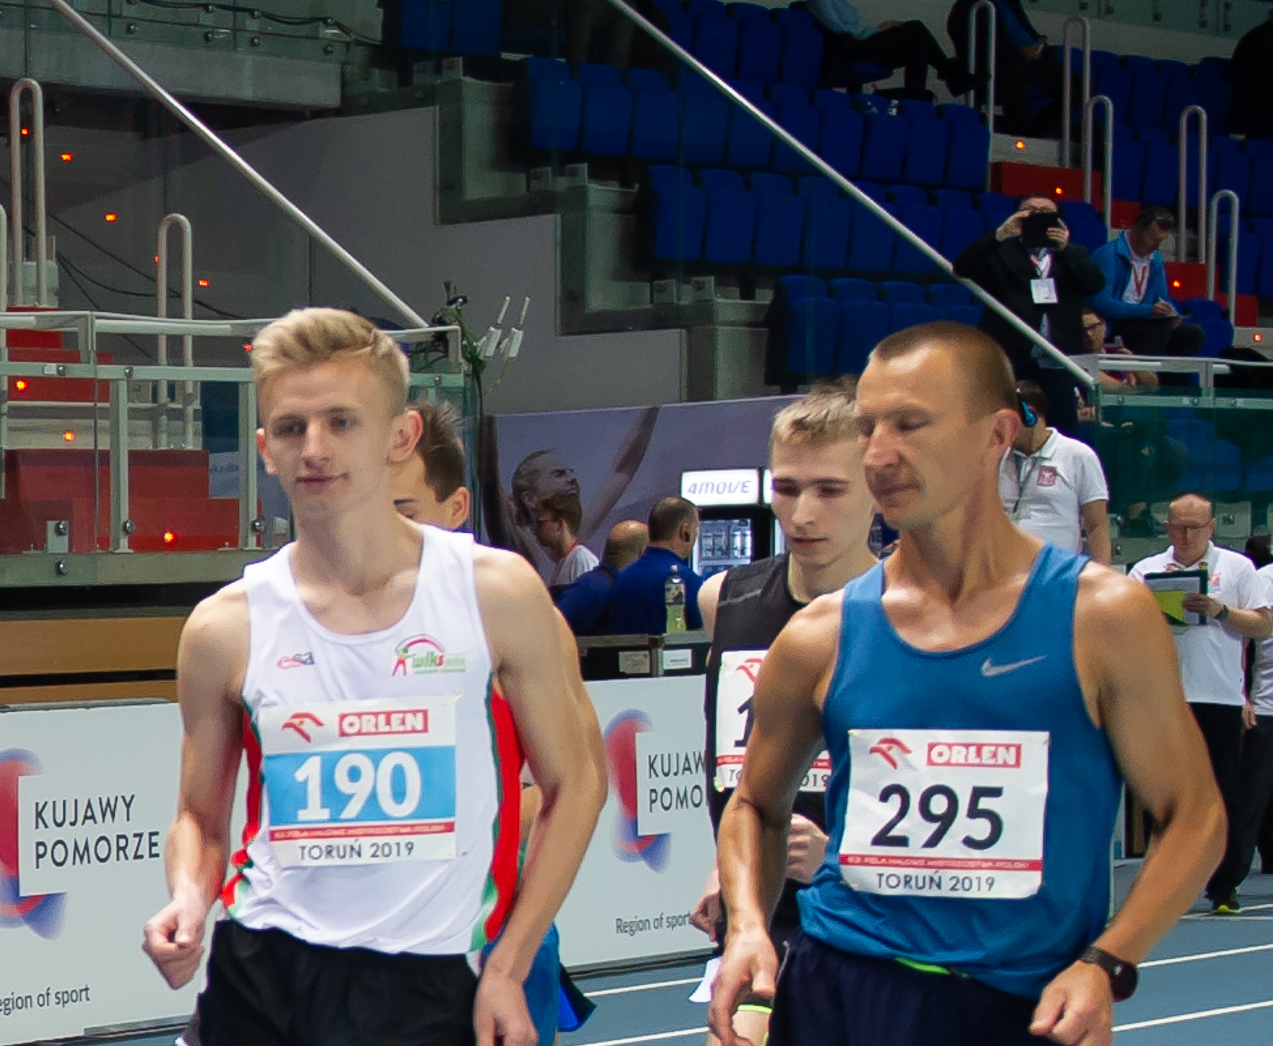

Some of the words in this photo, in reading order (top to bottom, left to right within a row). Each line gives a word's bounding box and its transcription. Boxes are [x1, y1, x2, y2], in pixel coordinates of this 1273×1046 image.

[687, 480, 752, 495] 4MOVE
[341, 712, 425, 734] ORLEN
[648, 750, 706, 779] KUJAW
[930, 744, 1017, 766] ORLEN
[294, 751, 422, 821] 190
[649, 784, 707, 813] POMO
[34, 794, 136, 830] KUJAWY
[870, 783, 1004, 850] 295
[35, 831, 161, 870] POMORZE
[299, 838, 362, 861] TORUŃ
[370, 841, 415, 858] 2019
[876, 870, 942, 891] TORUŃ
[949, 876, 996, 892] 2019
[615, 915, 651, 937] Region
[653, 914, 664, 930] of
[37, 987, 51, 1006] of
[54, 984, 91, 1009] sport
